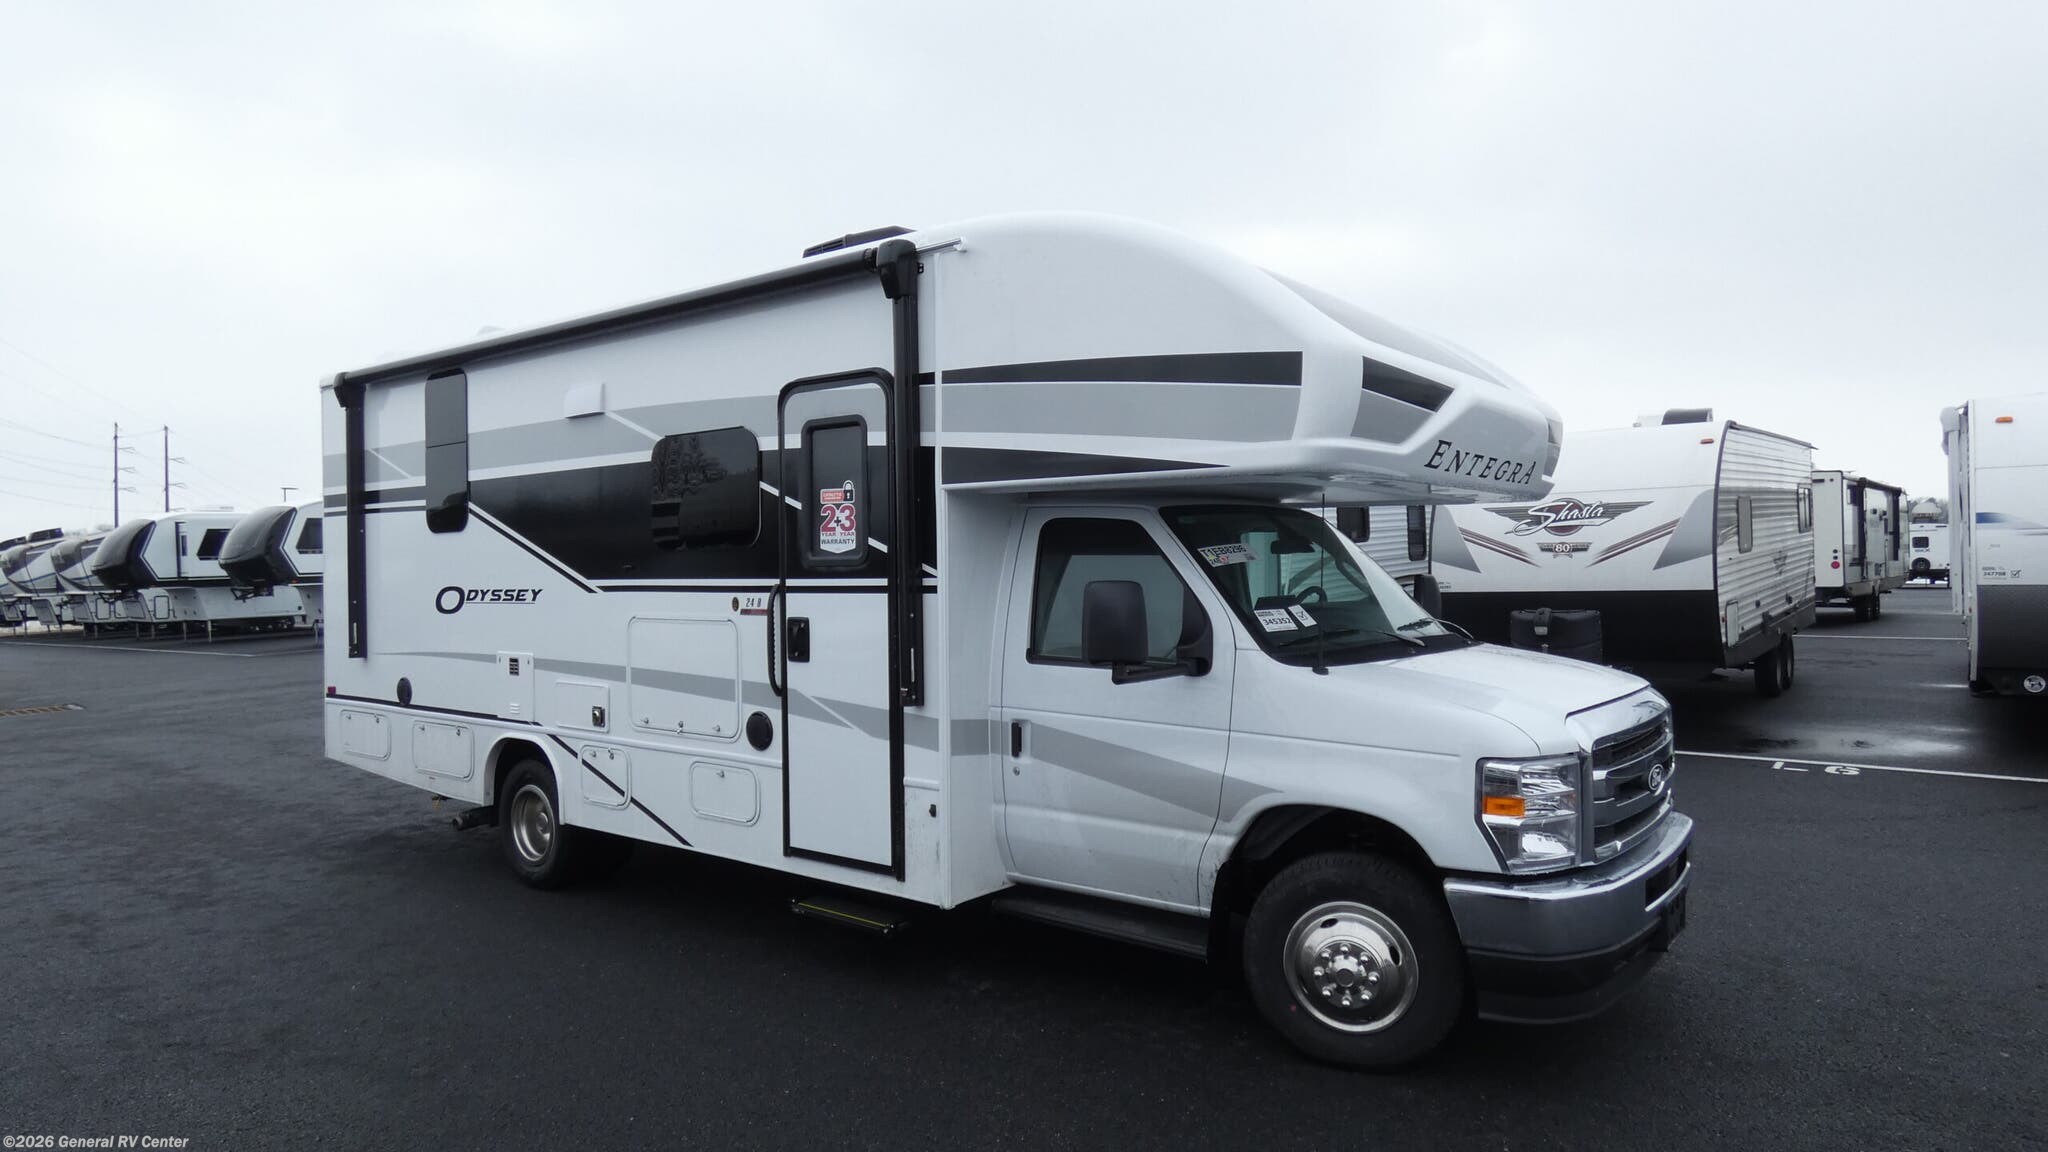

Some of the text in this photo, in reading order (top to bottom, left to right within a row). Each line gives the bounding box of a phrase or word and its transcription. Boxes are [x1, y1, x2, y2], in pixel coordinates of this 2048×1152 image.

[1424, 439, 1537, 485] ENTEGRA
[1510, 500, 1606, 536] Shasta
[1555, 543, 1570, 553] 80
[436, 586, 543, 614] ODYSSEY
